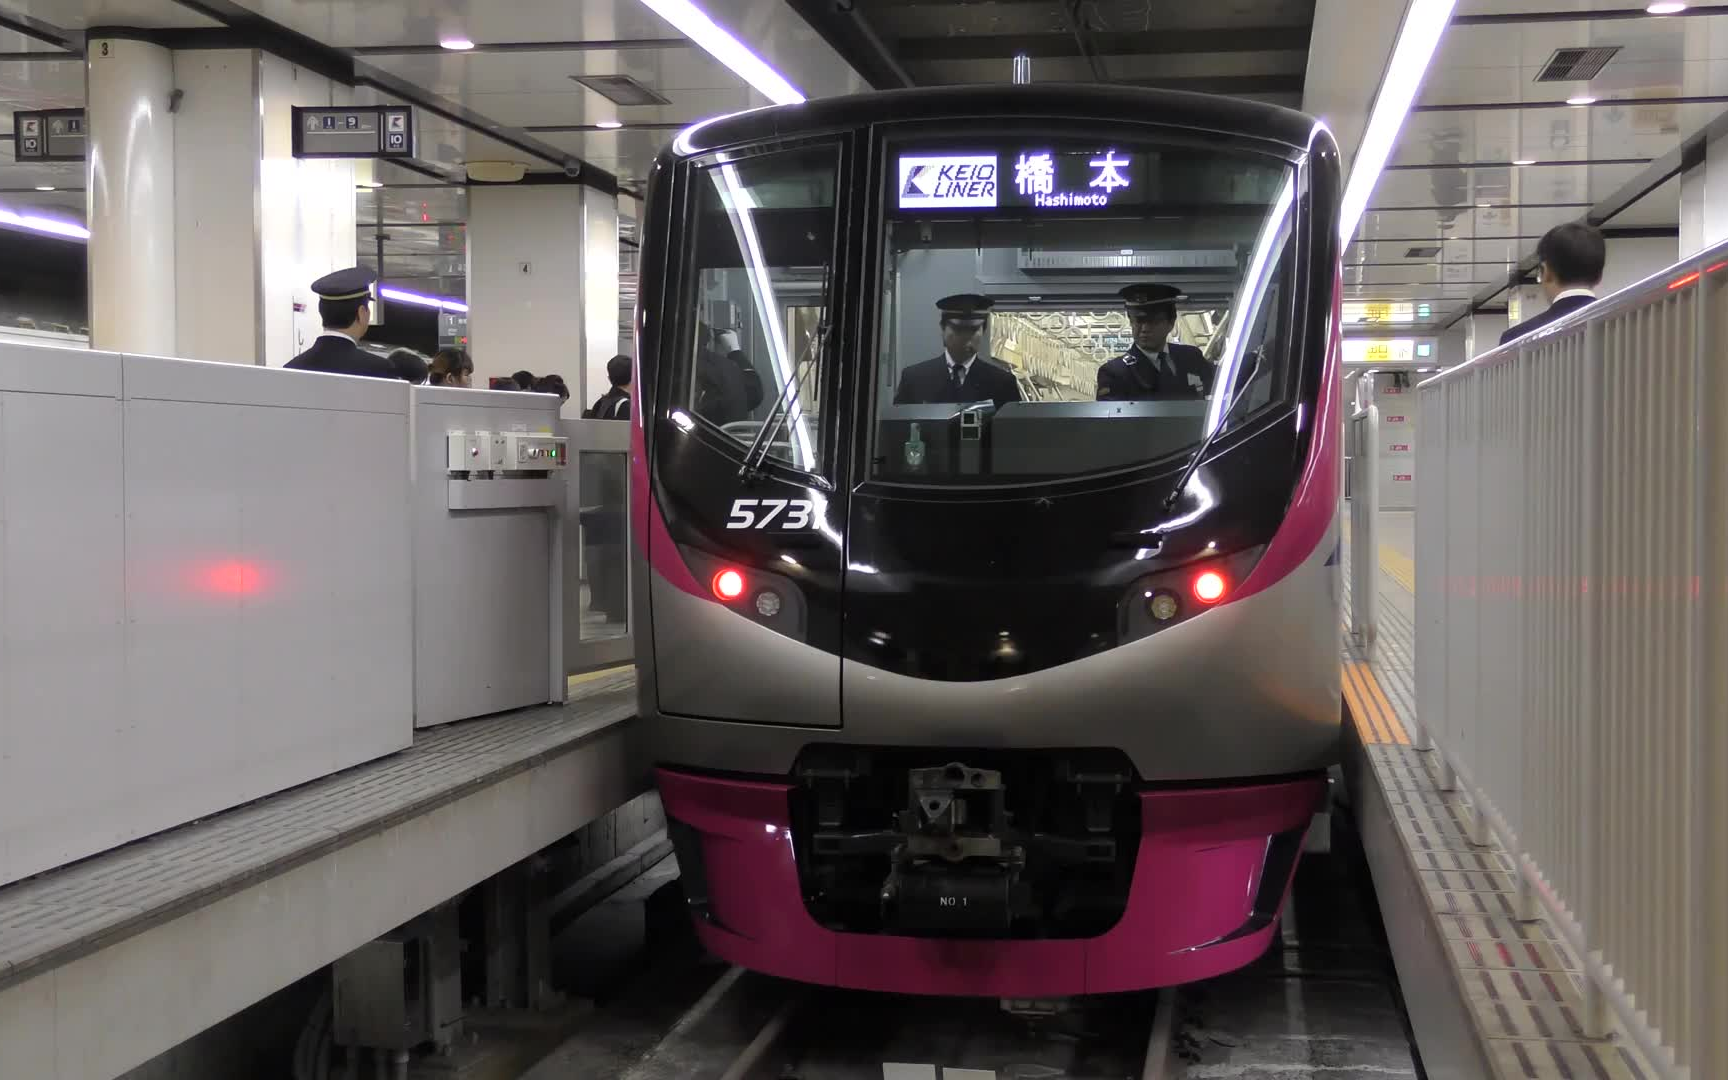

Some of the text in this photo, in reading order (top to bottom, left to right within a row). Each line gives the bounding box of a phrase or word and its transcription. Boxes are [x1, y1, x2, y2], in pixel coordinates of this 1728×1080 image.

[102, 42, 108, 56] 3
[348, 117, 356, 126] 9
[25, 139, 37, 149] 10
[391, 135, 402, 144] 10
[938, 164, 995, 181] KEIO
[933, 181, 995, 198] LINER
[1035, 194, 1107, 207] Hashimoto
[940, 896, 955, 906] NO
